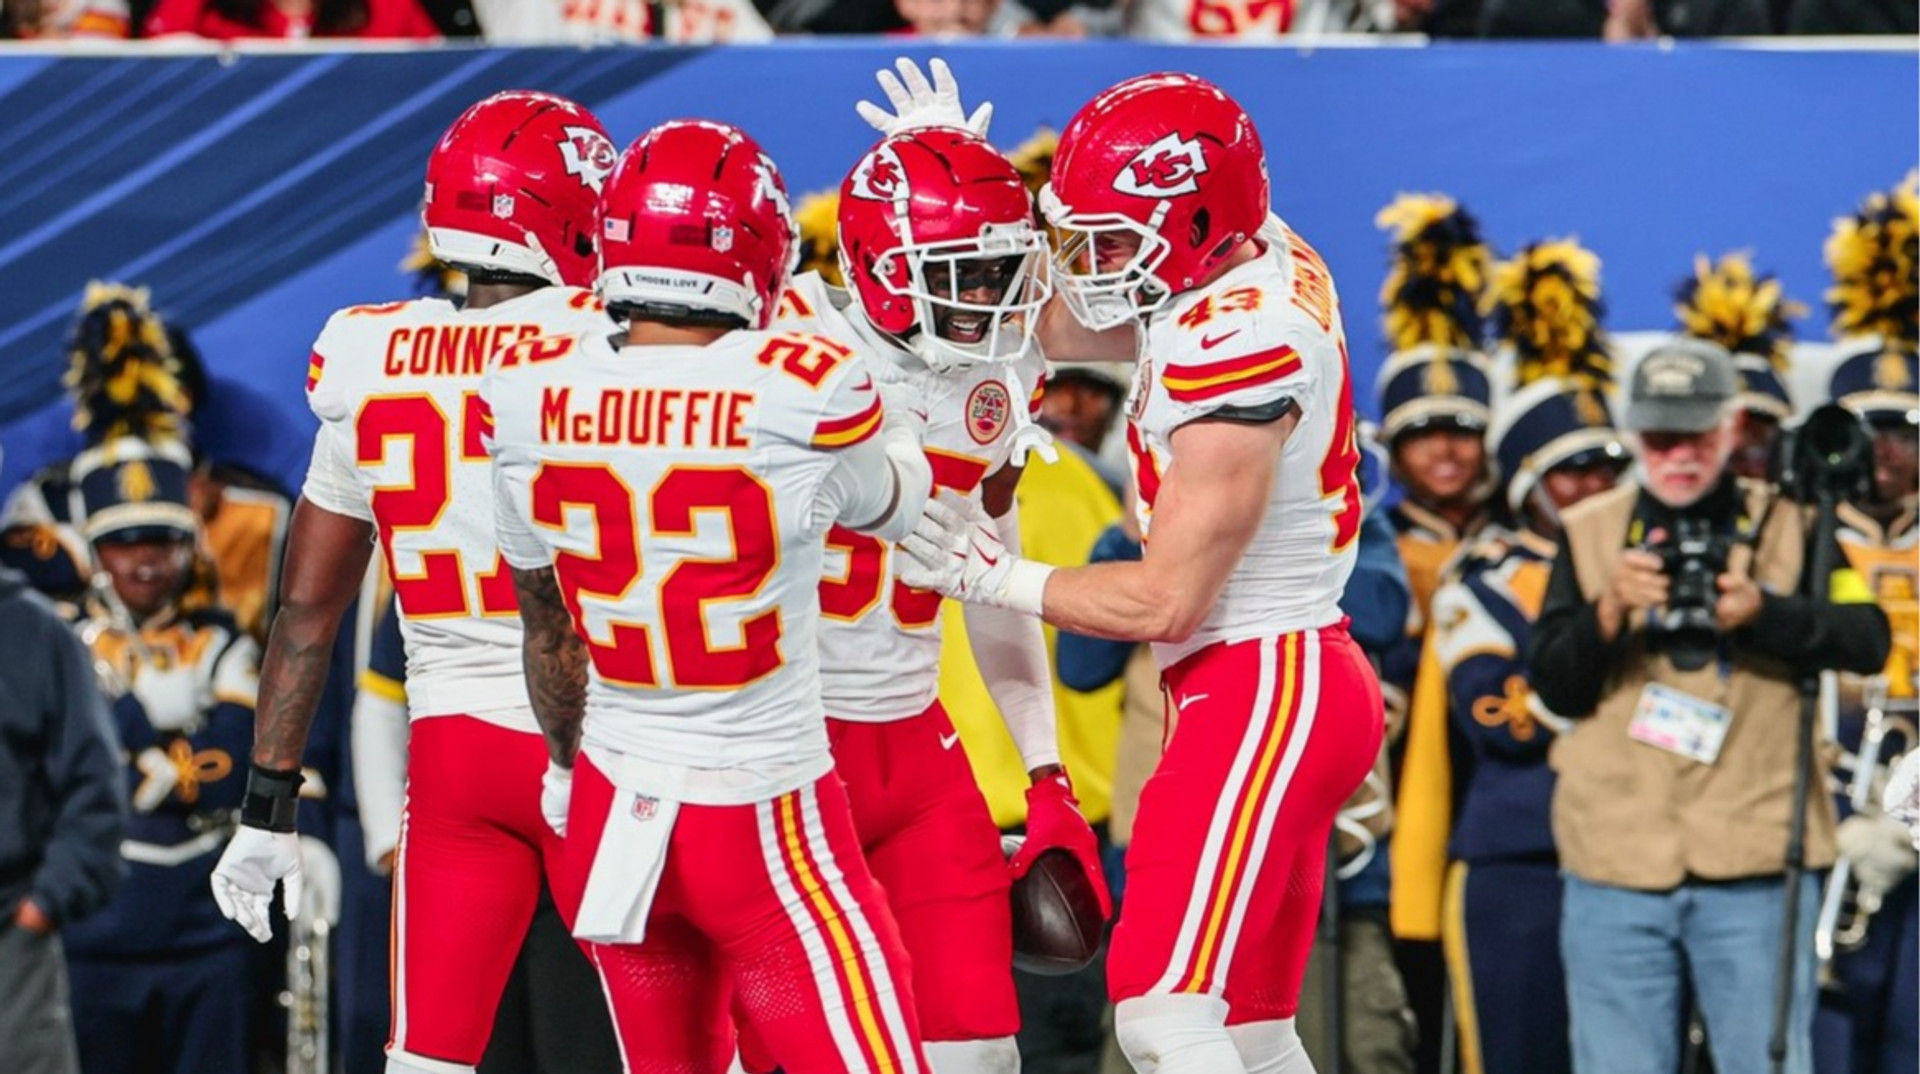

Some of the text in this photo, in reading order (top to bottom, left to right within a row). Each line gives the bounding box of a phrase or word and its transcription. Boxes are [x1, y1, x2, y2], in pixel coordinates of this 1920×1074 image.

[1129, 149, 1195, 189] KC
[635, 273, 698, 288] CHOOSE LOVE
[540, 385, 754, 449] McDUFFIE
[530, 458, 787, 692] 22
